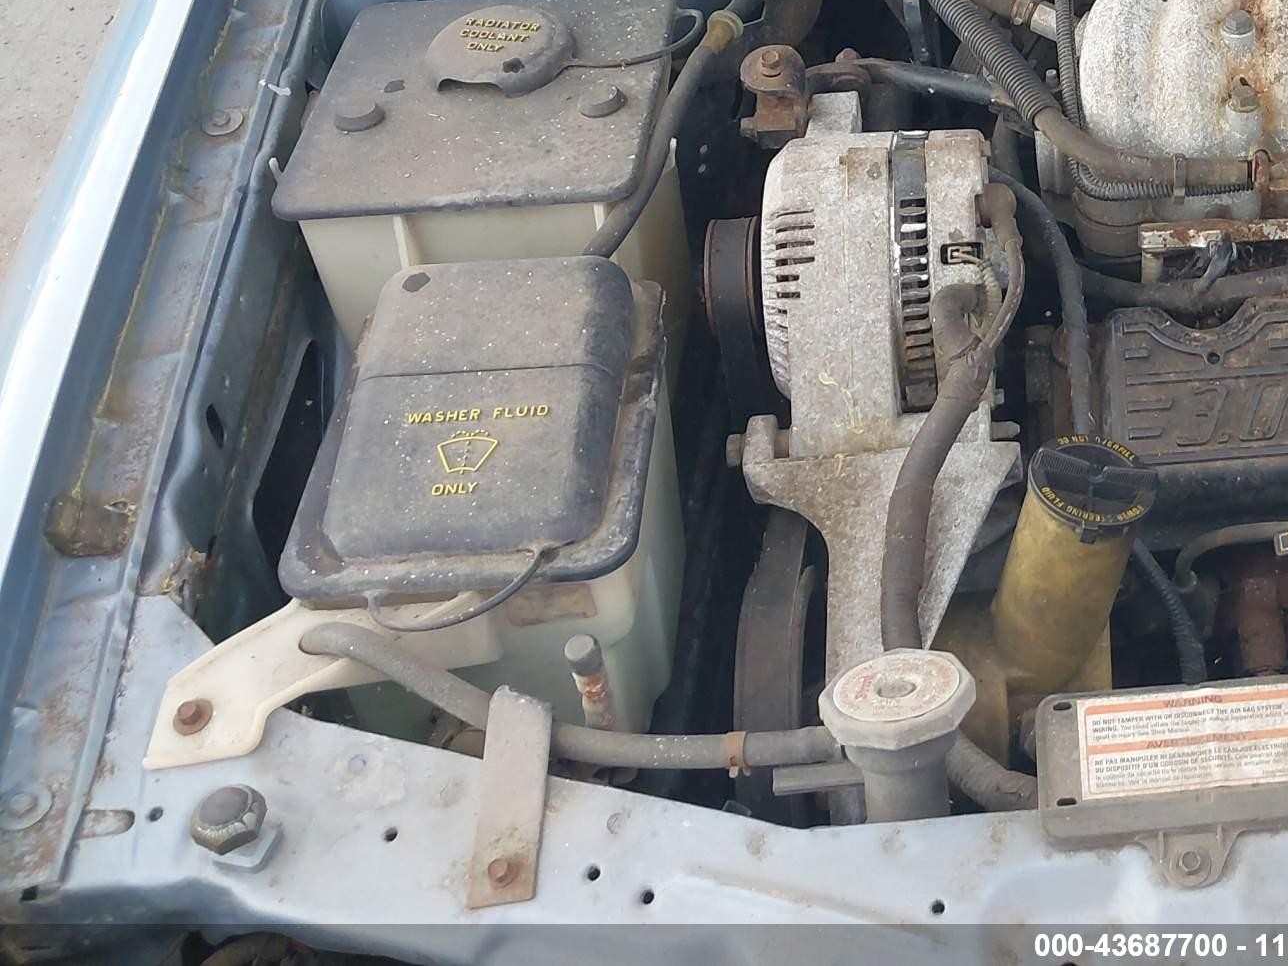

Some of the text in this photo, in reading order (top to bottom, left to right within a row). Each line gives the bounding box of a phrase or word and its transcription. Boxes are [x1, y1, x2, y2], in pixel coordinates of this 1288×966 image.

[465, 17, 541, 32] RADIATOR
[459, 28, 530, 42] COOLANT
[466, 41, 504, 52] ONLY
[408, 404, 550, 425] WASHER FLUID
[431, 481, 478, 497] ONLY
[1041, 486, 1065, 508] FLUID
[1163, 694, 1222, 709] WARNING
[1102, 718, 1115, 726] NOT
[1117, 716, 1144, 725] TAMPER
[1145, 714, 1162, 722] WITH
[1174, 708, 1214, 719] DISCONNECT
[1216, 708, 1229, 716] THE
[1230, 706, 1241, 714] AIR
[1257, 703, 1283, 712] SYSTEM
[1094, 758, 1104, 766] NE
[1105, 757, 1119, 766] PAS
[1119, 753, 1159, 764] MANIPULER
[1106, 763, 1141, 773] DISPOSITIF
